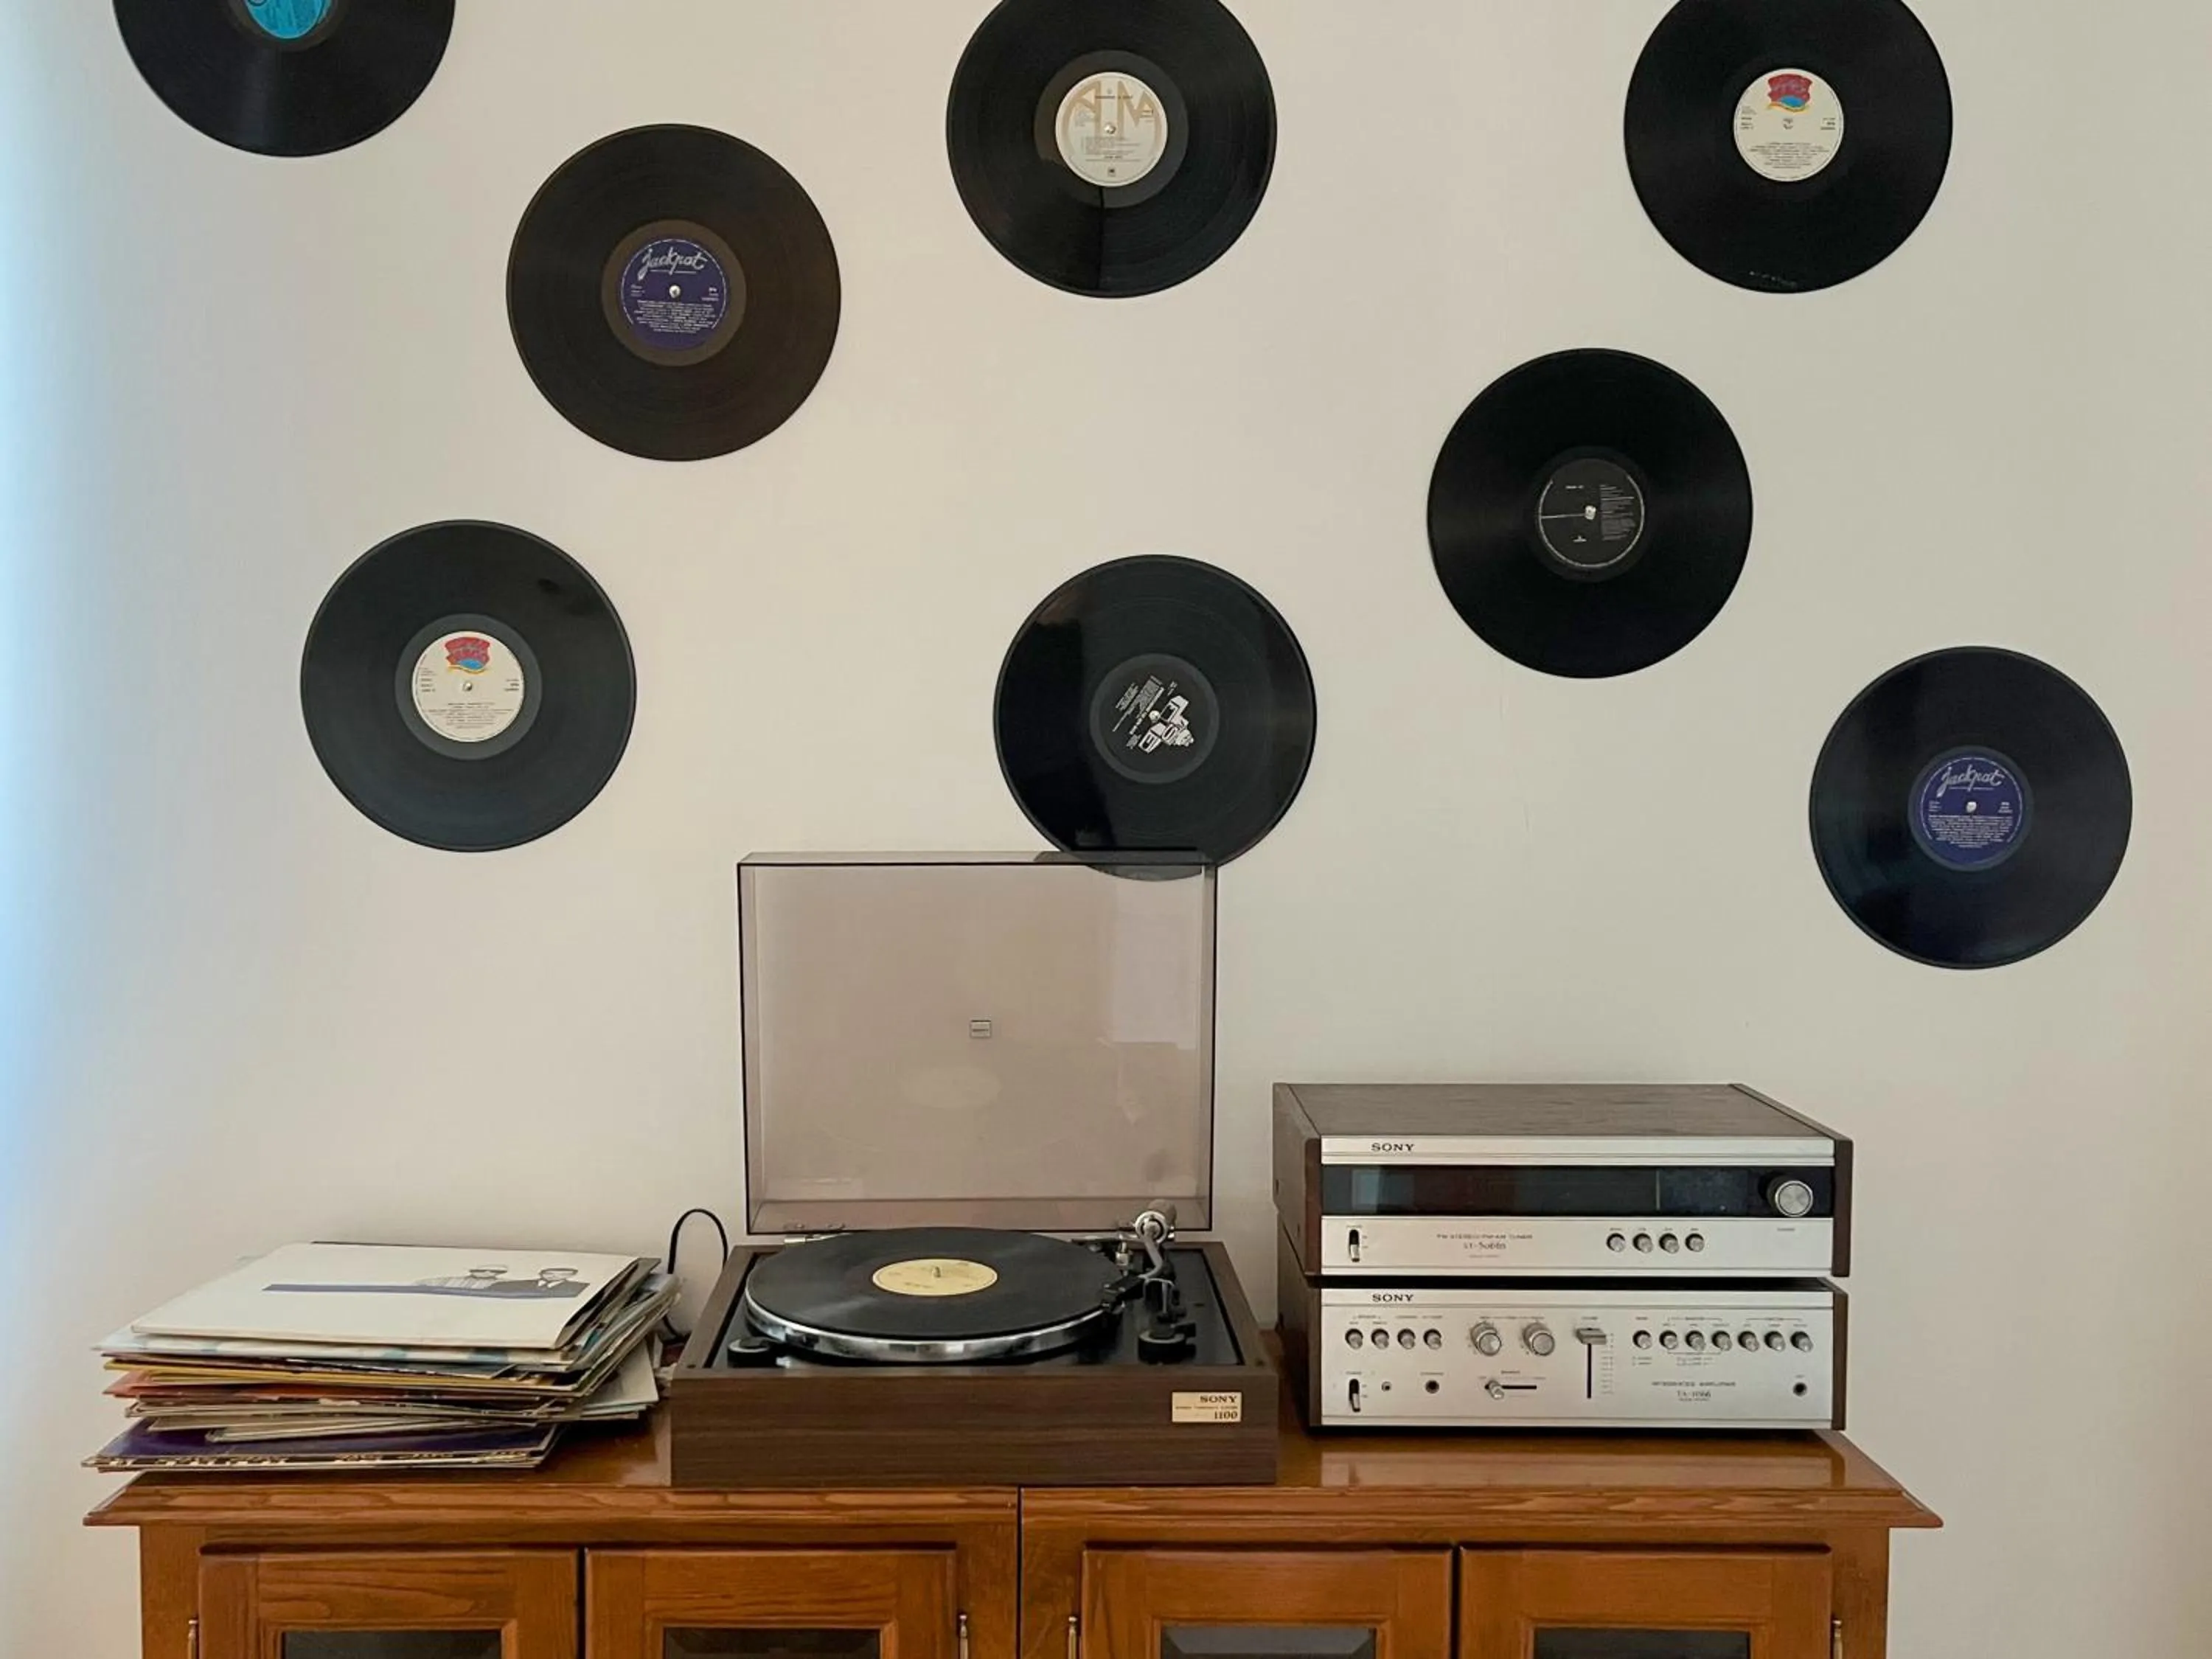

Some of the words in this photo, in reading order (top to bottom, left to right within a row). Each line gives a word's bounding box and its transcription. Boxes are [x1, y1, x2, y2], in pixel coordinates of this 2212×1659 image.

[1371, 1142, 1414, 1151] SONY
[1372, 1293, 1413, 1302] SONY
[1200, 1395, 1237, 1403] SONY
[1214, 1411, 1238, 1420] 1100
